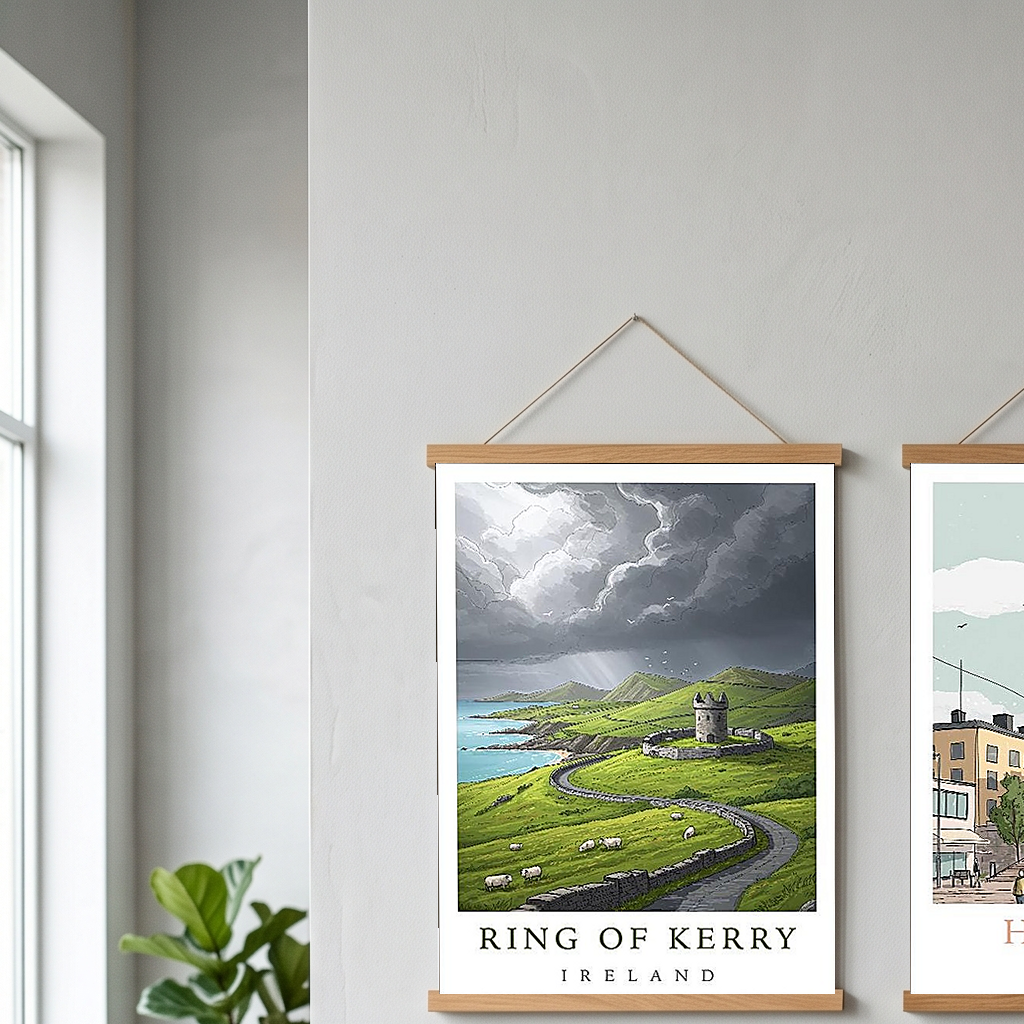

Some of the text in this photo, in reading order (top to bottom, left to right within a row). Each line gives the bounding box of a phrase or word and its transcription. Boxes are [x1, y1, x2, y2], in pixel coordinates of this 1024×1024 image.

[480, 926, 797, 951] RING OF KERRY
[561, 968, 717, 982] IRELAND
